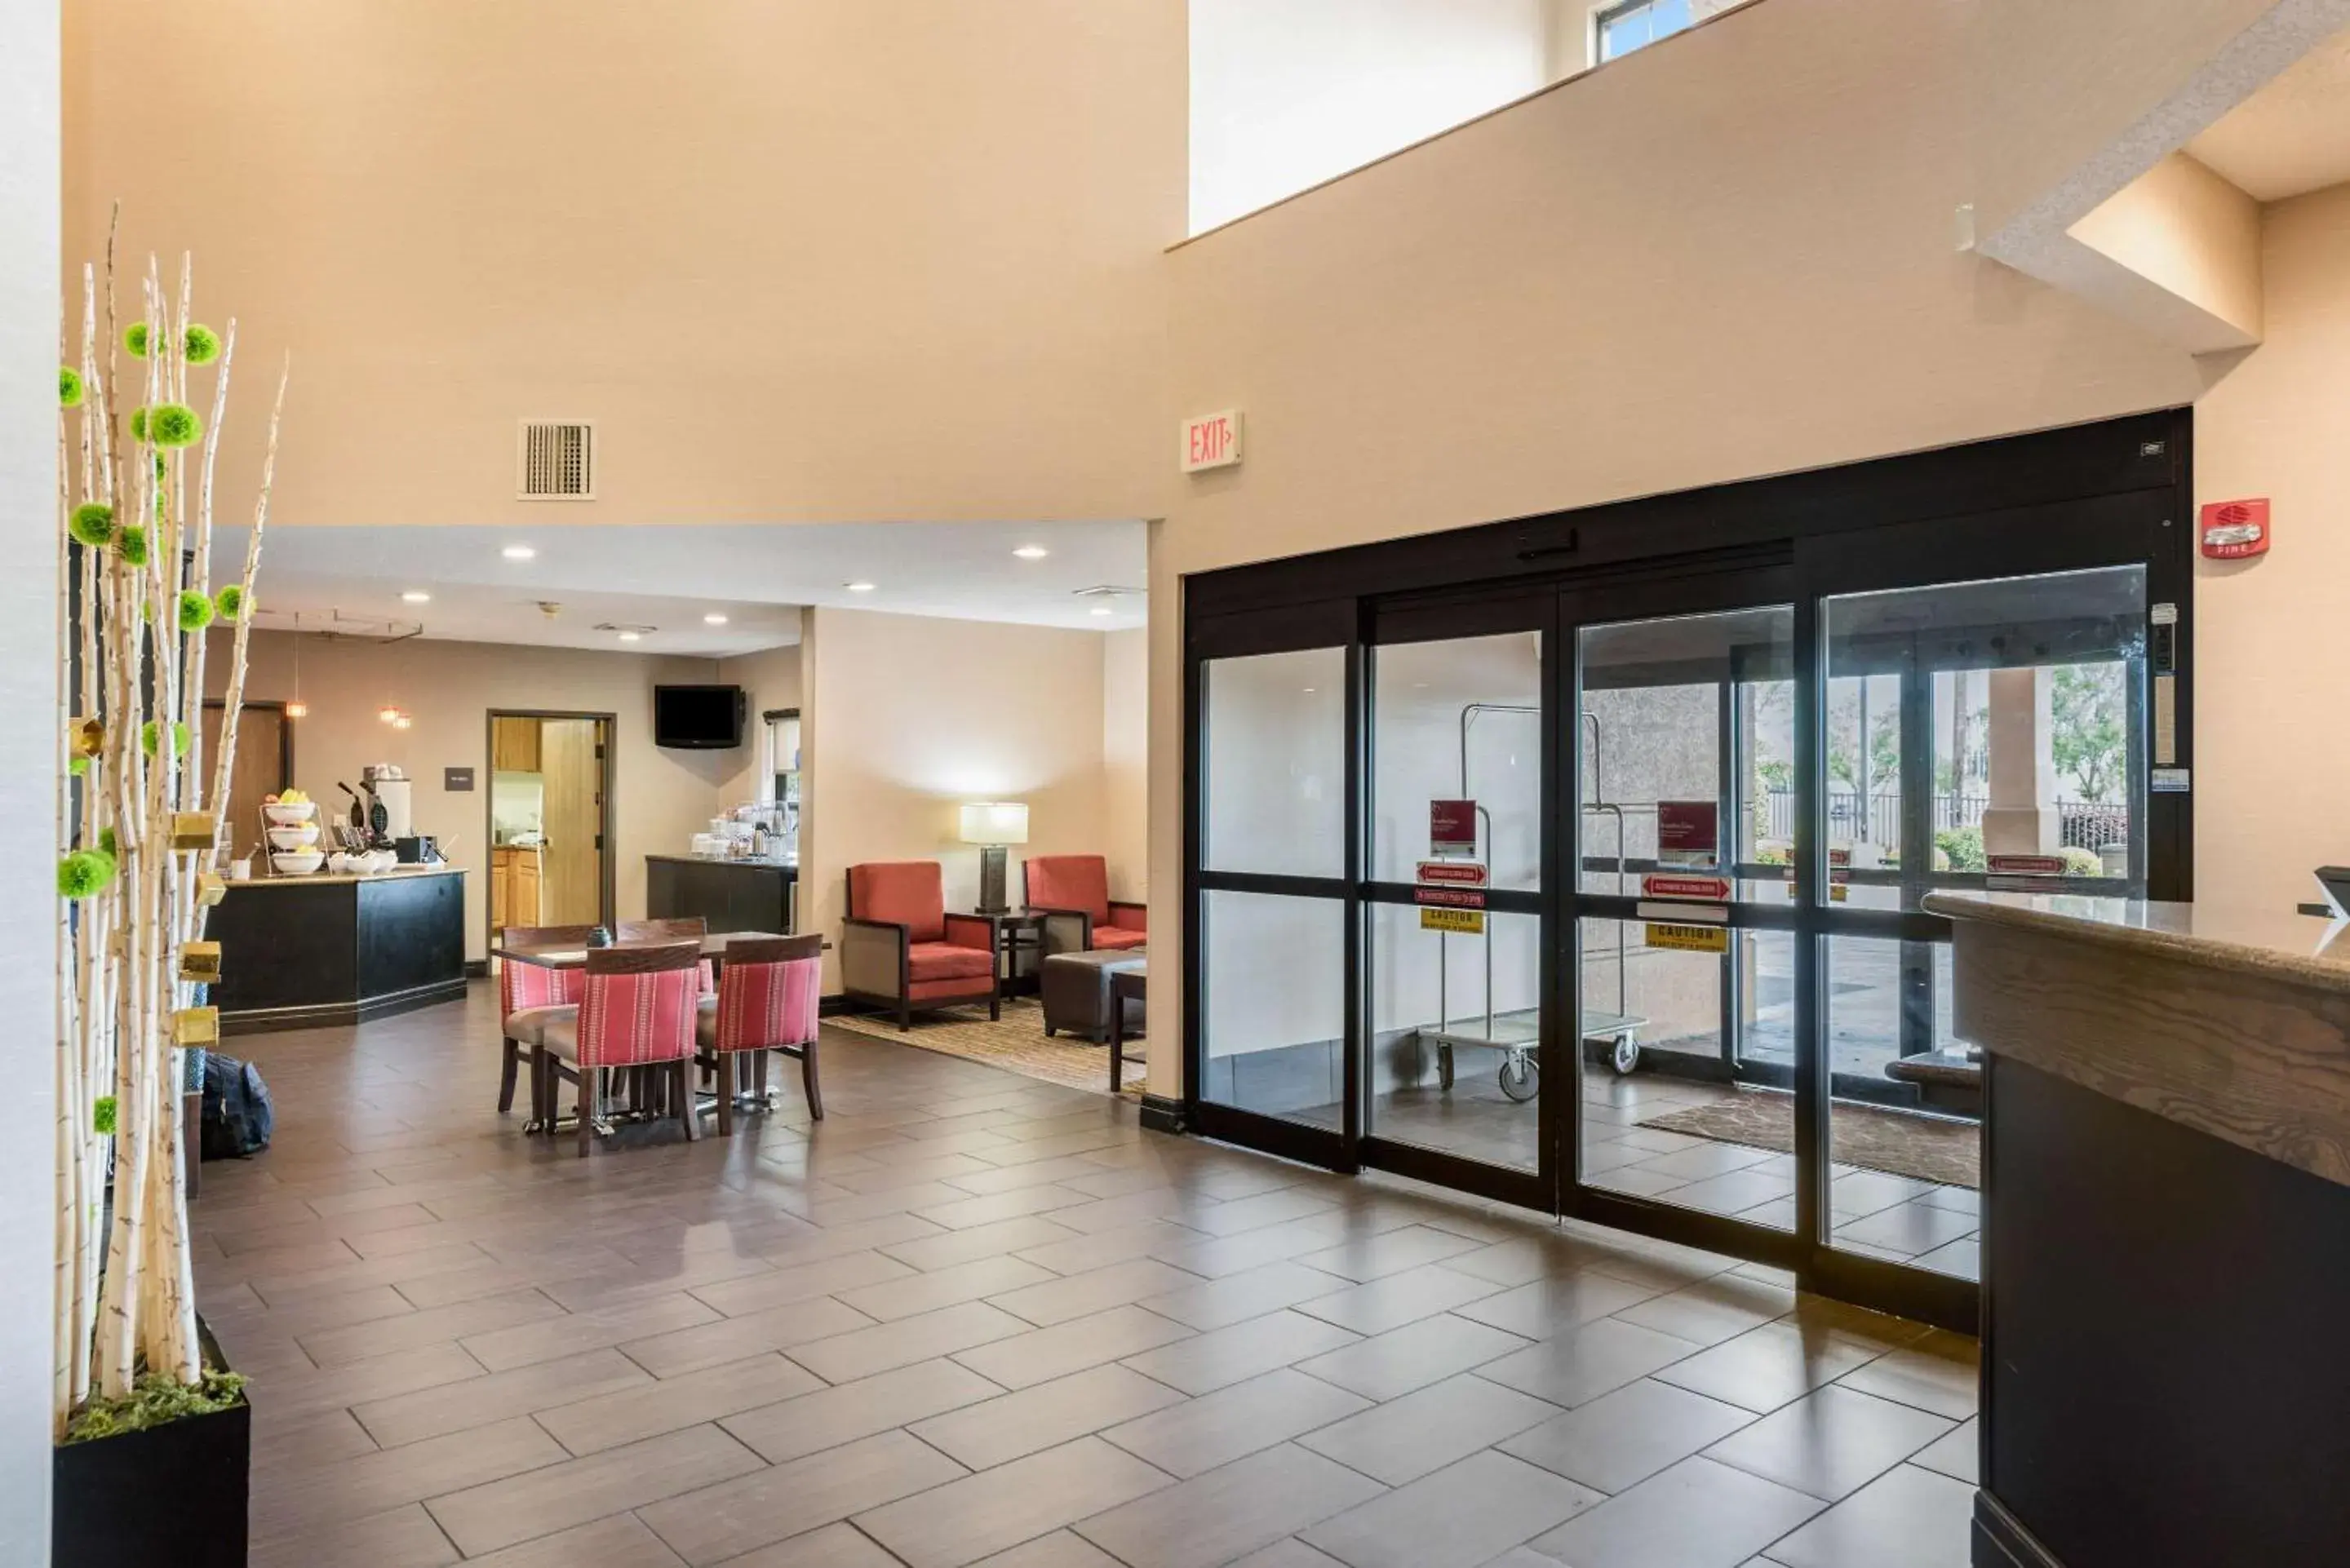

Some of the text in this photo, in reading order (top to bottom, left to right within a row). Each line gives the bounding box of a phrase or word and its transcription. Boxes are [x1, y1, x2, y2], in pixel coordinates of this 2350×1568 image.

[1190, 418, 1226, 464] EXIT
[2217, 544, 2248, 555] FIRE
[1658, 925, 1714, 941] CAUTION
